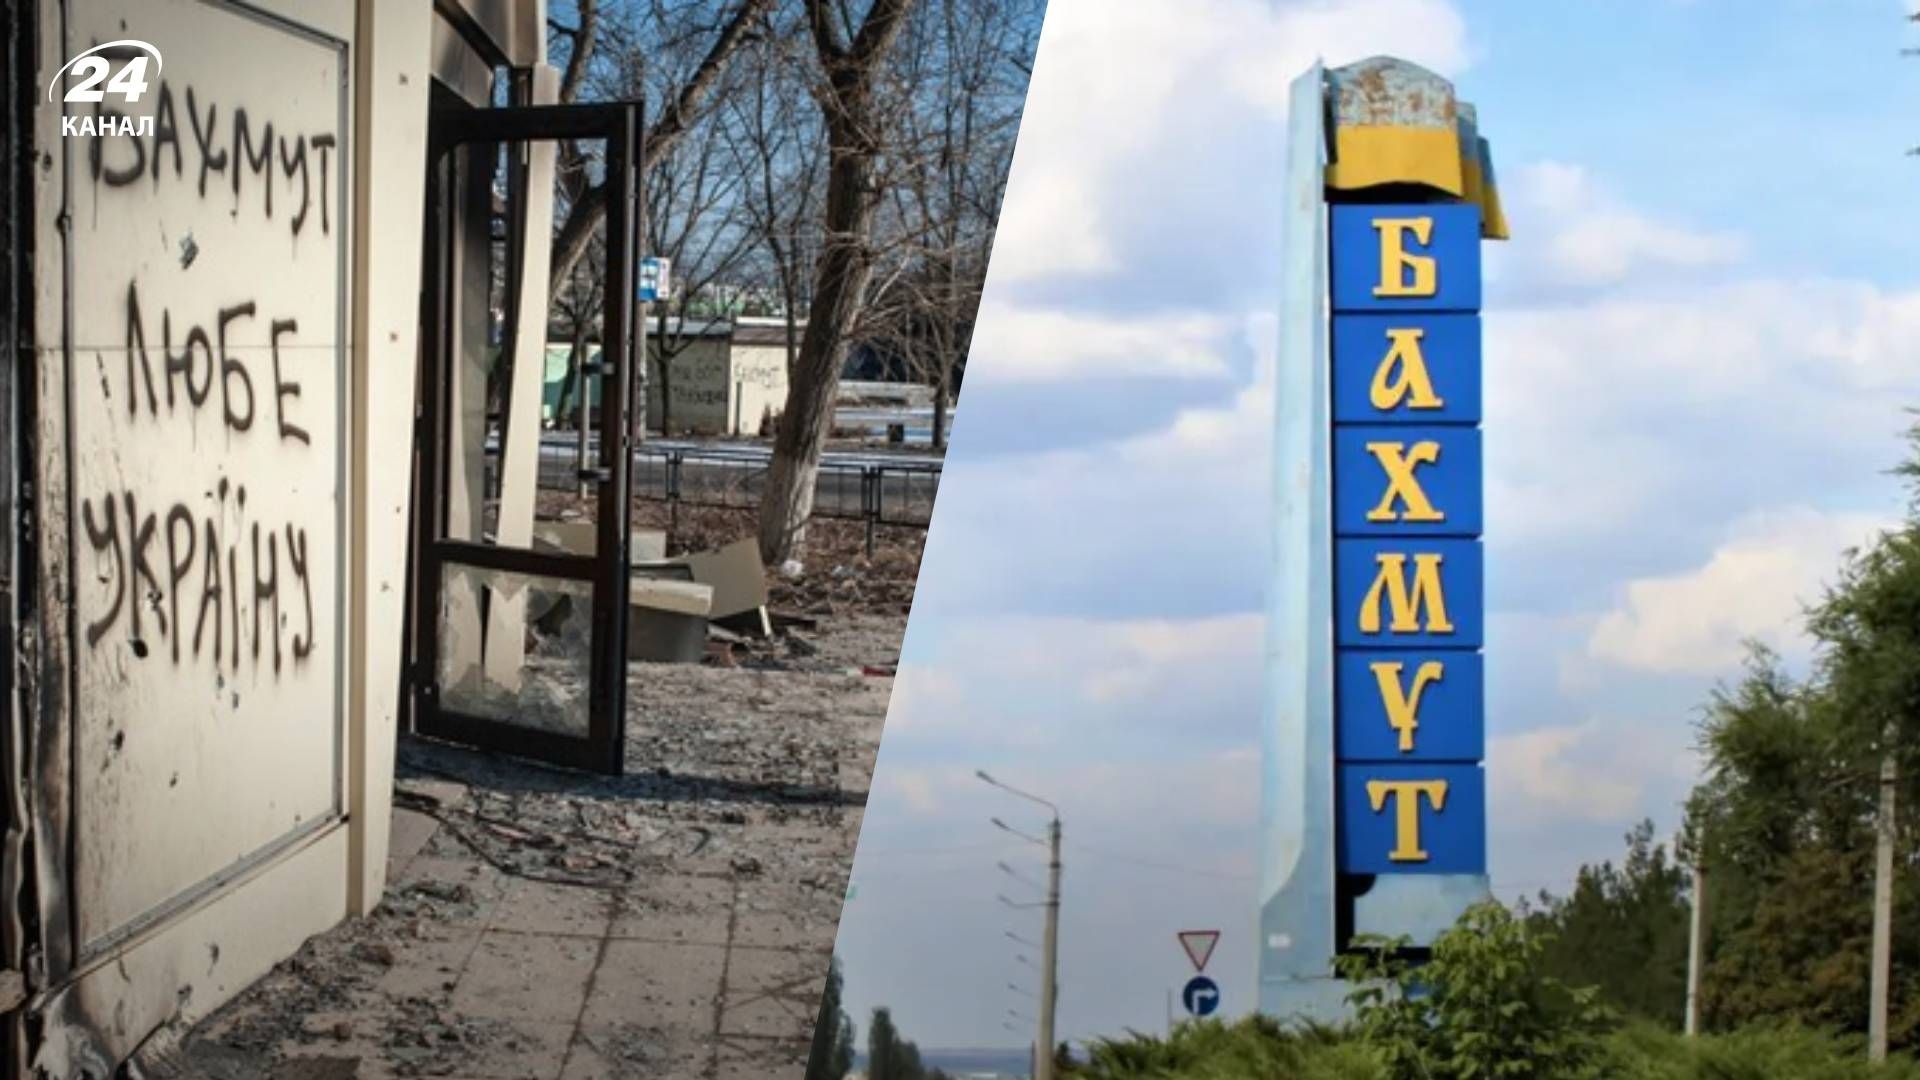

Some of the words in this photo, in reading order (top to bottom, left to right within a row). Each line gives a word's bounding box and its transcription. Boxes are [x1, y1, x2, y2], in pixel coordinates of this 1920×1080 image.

[127, 281, 311, 446] ЛЮБЕ
[83, 477, 314, 679] УКРАЇНУ
[1359, 215, 1453, 862] БАХМУТ
